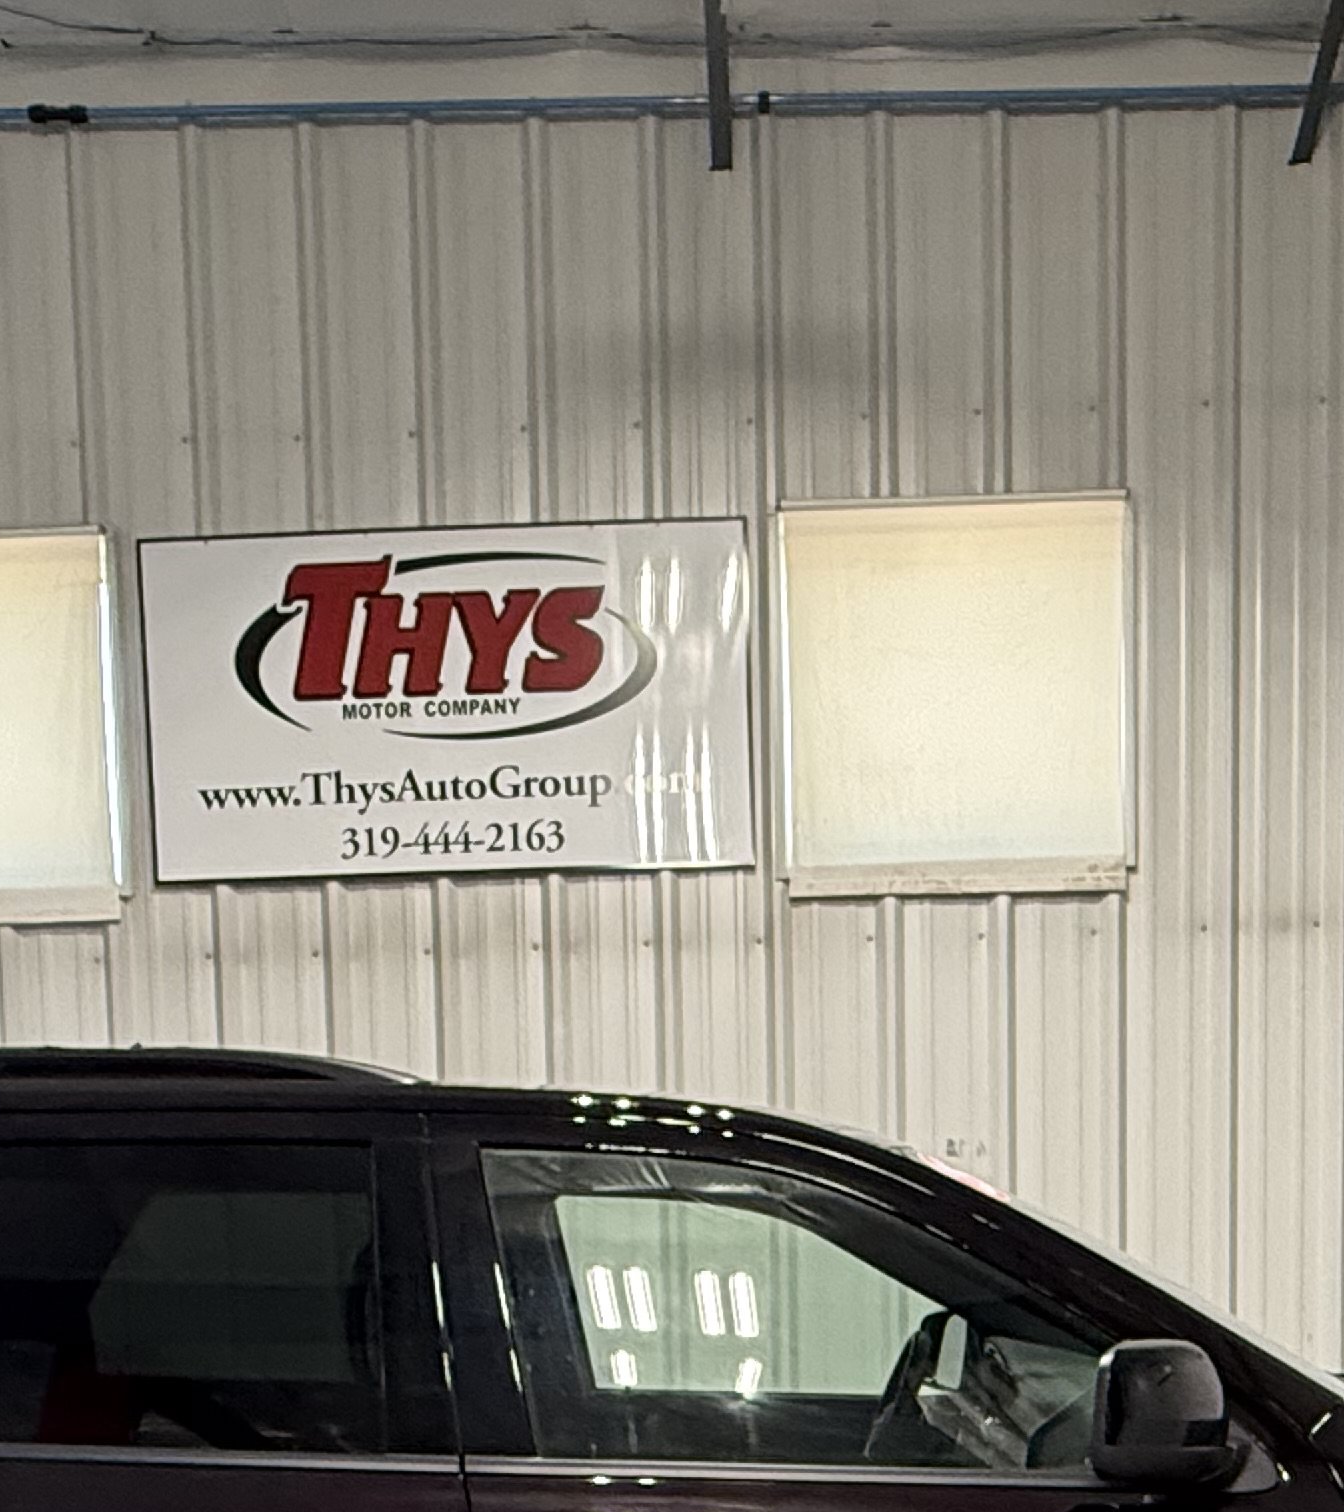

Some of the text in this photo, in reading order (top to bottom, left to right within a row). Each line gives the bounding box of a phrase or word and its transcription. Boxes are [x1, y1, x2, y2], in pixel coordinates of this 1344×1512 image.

[282, 554, 606, 701] THYS
[341, 698, 522, 721] MOTOR COMPANY
[341, 818, 566, 860] 319-444-2163
